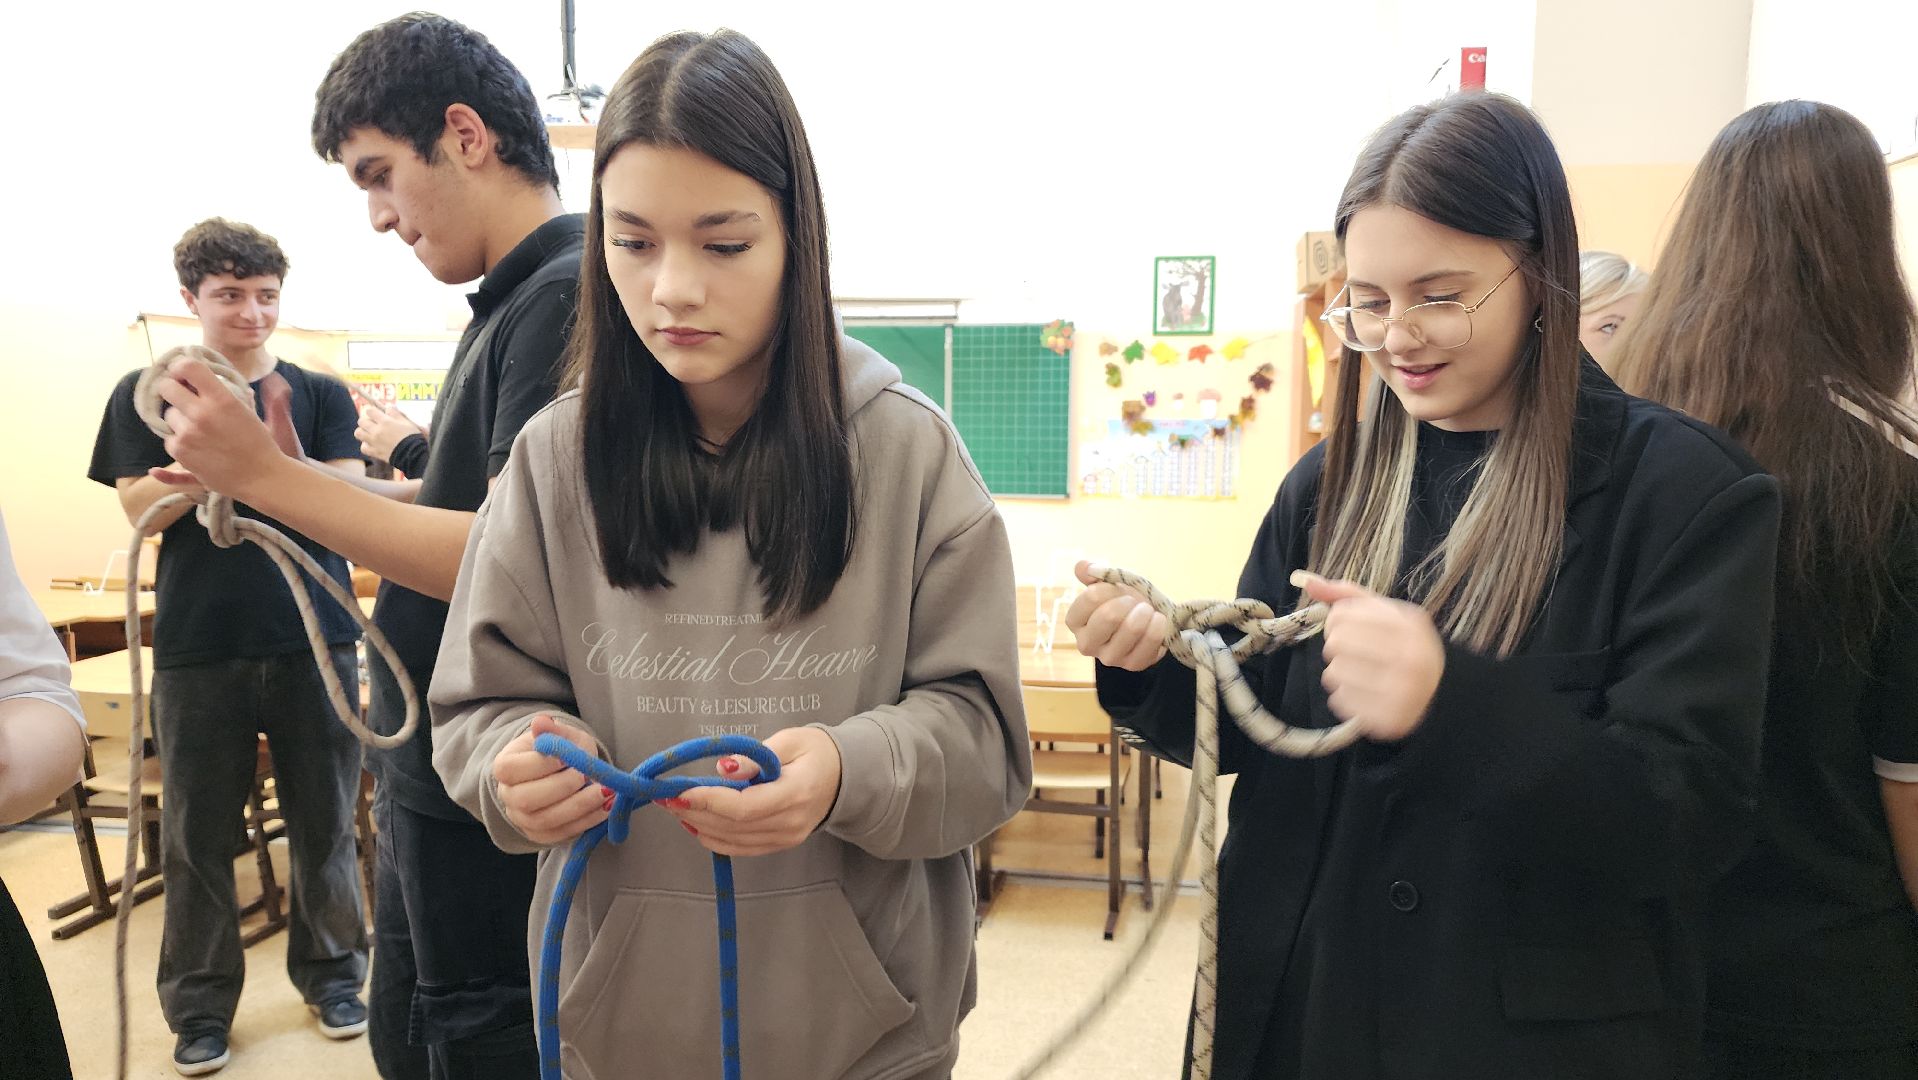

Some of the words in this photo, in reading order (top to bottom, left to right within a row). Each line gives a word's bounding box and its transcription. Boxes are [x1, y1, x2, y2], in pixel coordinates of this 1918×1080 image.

[582, 622, 736, 682] Celestial
[637, 696, 698, 714] BEAUTY
[701, 699, 713, 715] &
[715, 697, 778, 715] LEISURE
[779, 694, 821, 712] CLUB
